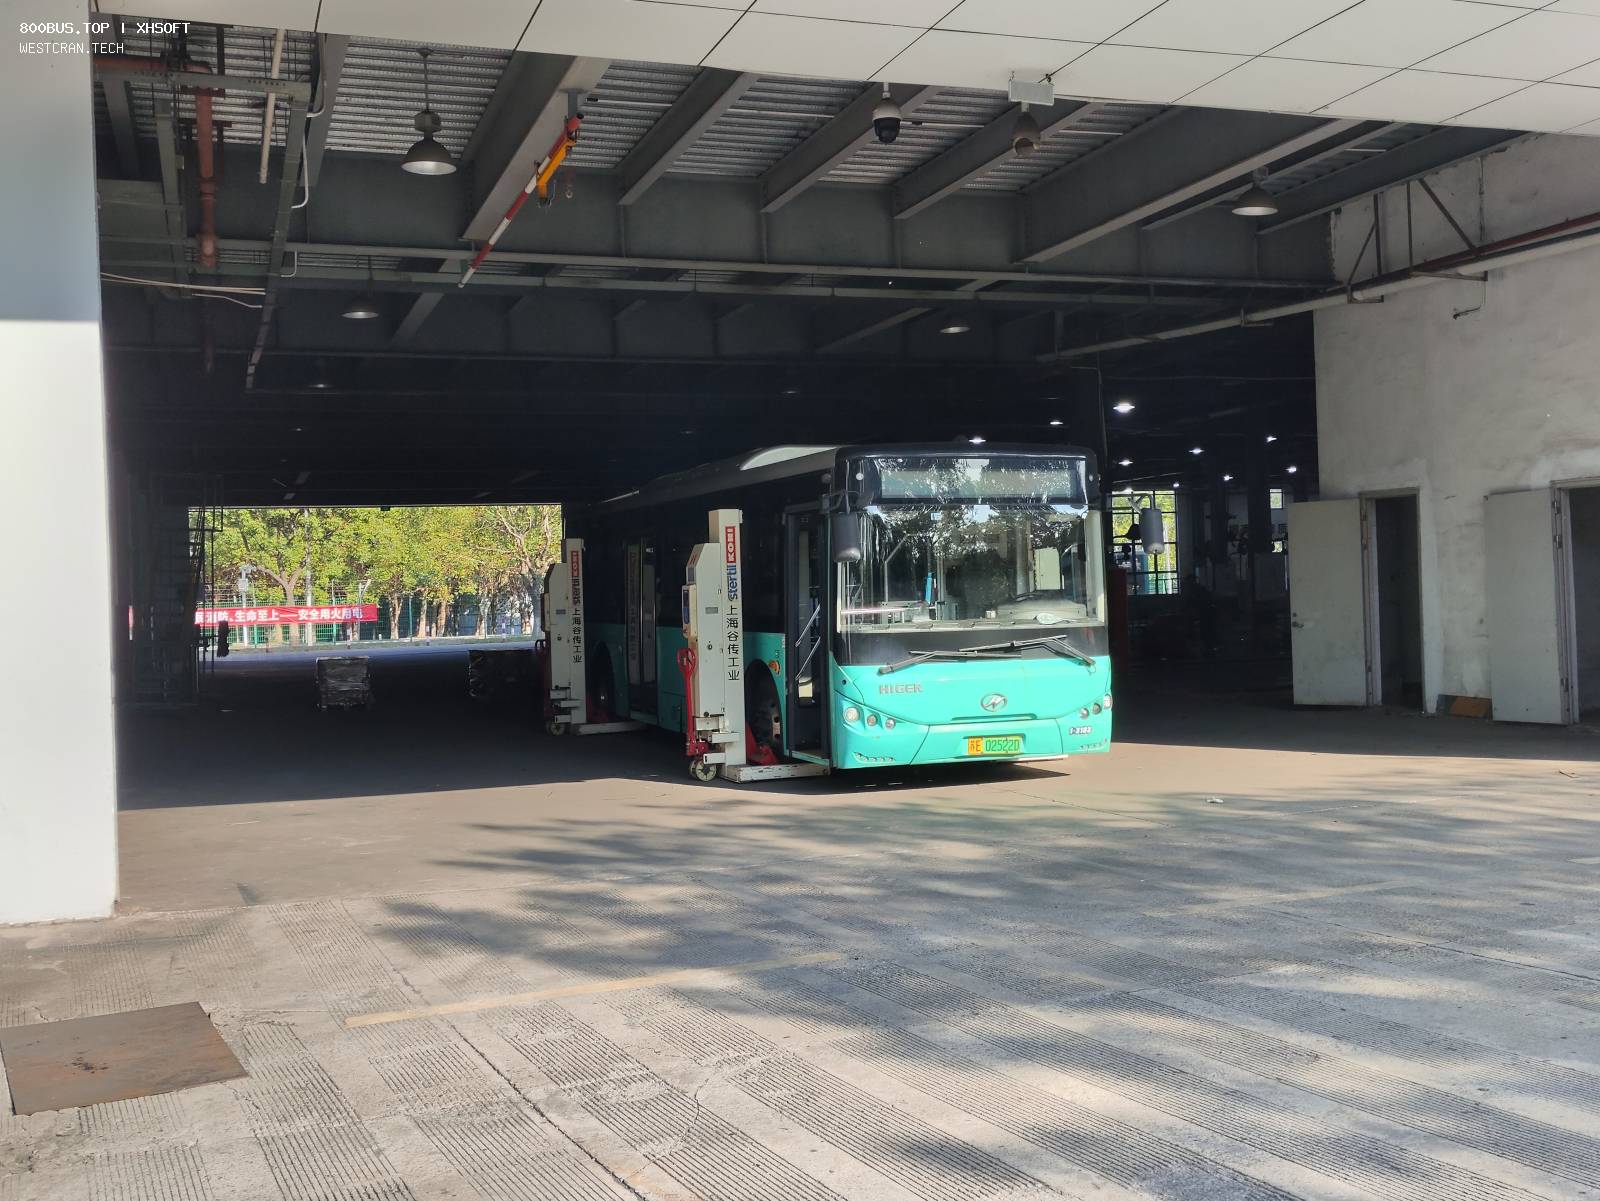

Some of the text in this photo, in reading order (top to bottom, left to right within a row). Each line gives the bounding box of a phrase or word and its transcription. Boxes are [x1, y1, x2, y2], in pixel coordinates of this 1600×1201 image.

[726, 565, 738, 602] stertil
[572, 608, 582, 663] 上海谷传工业
[726, 605, 740, 681] 上海谷传工业
[879, 684, 923, 694] HIGER
